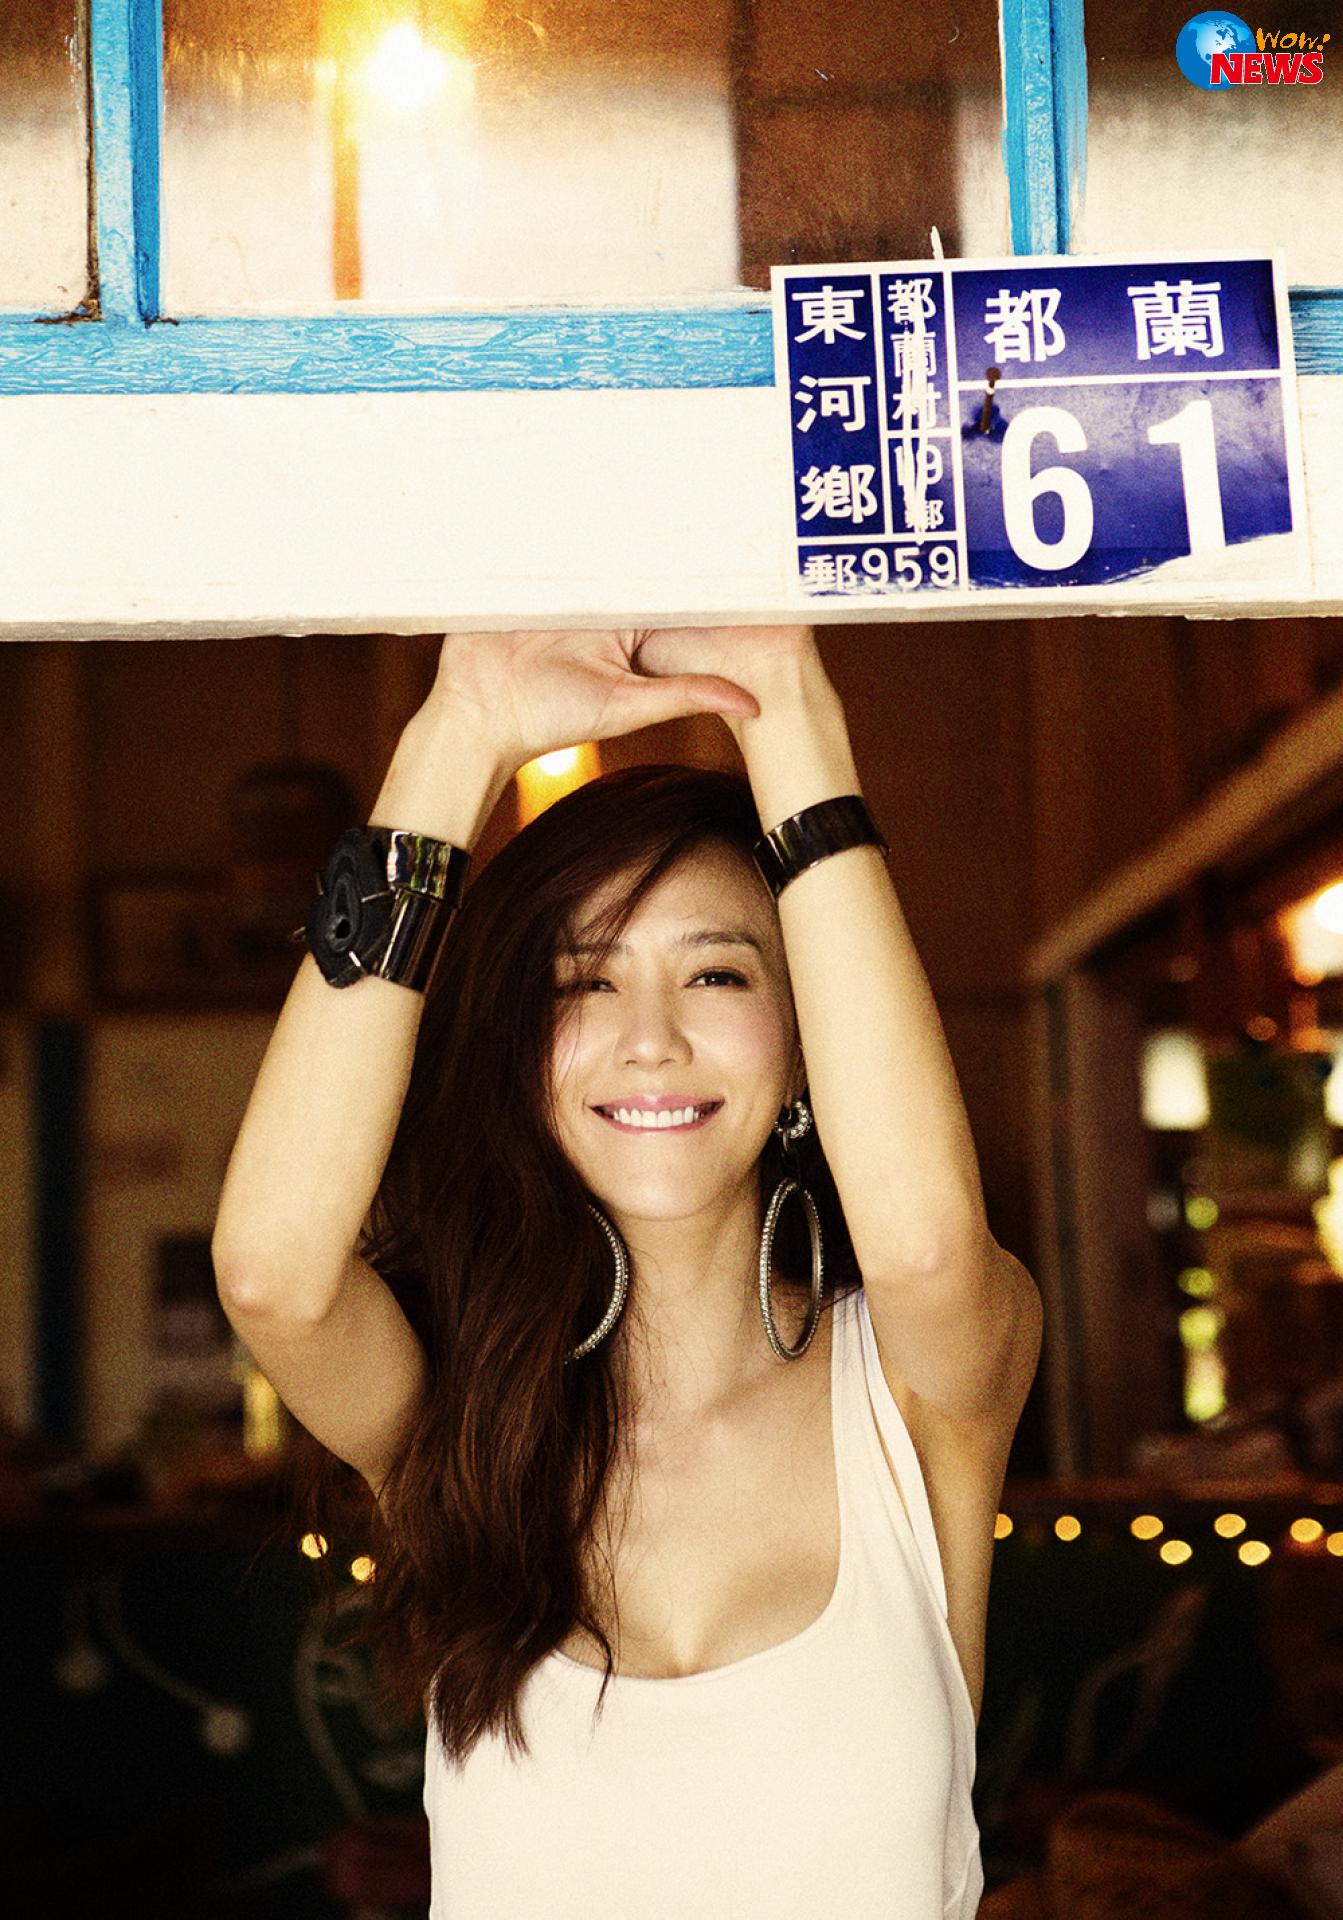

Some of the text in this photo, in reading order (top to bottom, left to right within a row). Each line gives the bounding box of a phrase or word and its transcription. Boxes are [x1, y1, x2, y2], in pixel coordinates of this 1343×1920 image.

[792, 285, 878, 525] 東河鄉
[983, 280, 1226, 364] 都蘭
[1001, 399, 1227, 572] 61
